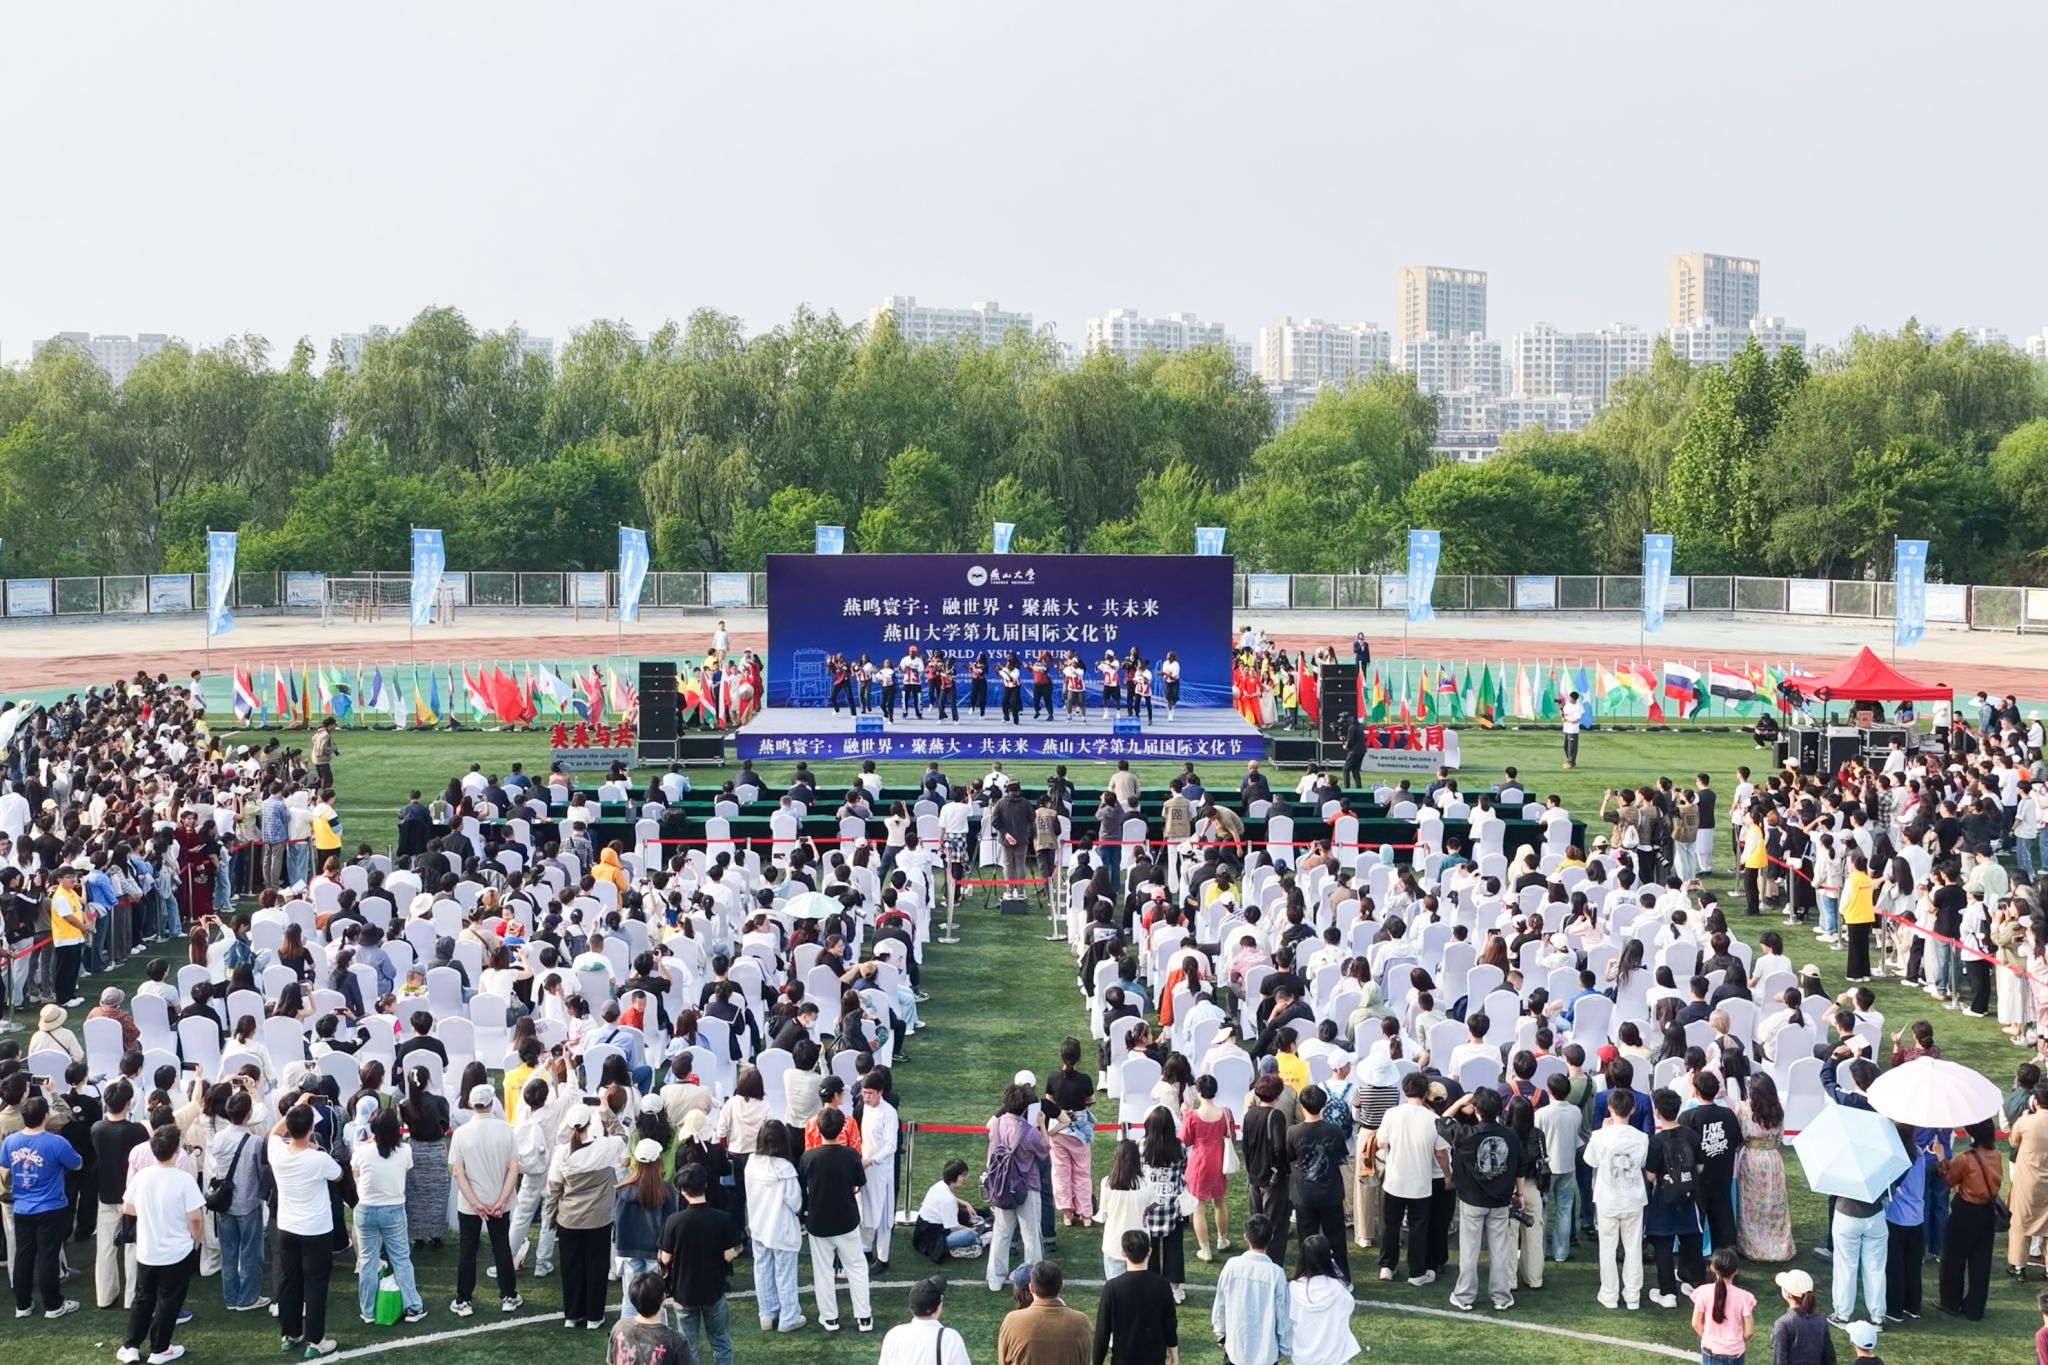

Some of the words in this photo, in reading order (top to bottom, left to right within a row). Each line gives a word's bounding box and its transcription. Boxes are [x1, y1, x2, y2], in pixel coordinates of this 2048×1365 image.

[883, 623, 1119, 643] 燕山大学第九届国际文化节
[550, 722, 635, 749] 美美与共
[1364, 724, 1445, 752] 天下大同
[1041, 737, 1243, 755] 燕山大学第九届国际文化节
[1703, 1121, 1723, 1133] LIVE
[1703, 1129, 1725, 1142] LONG
